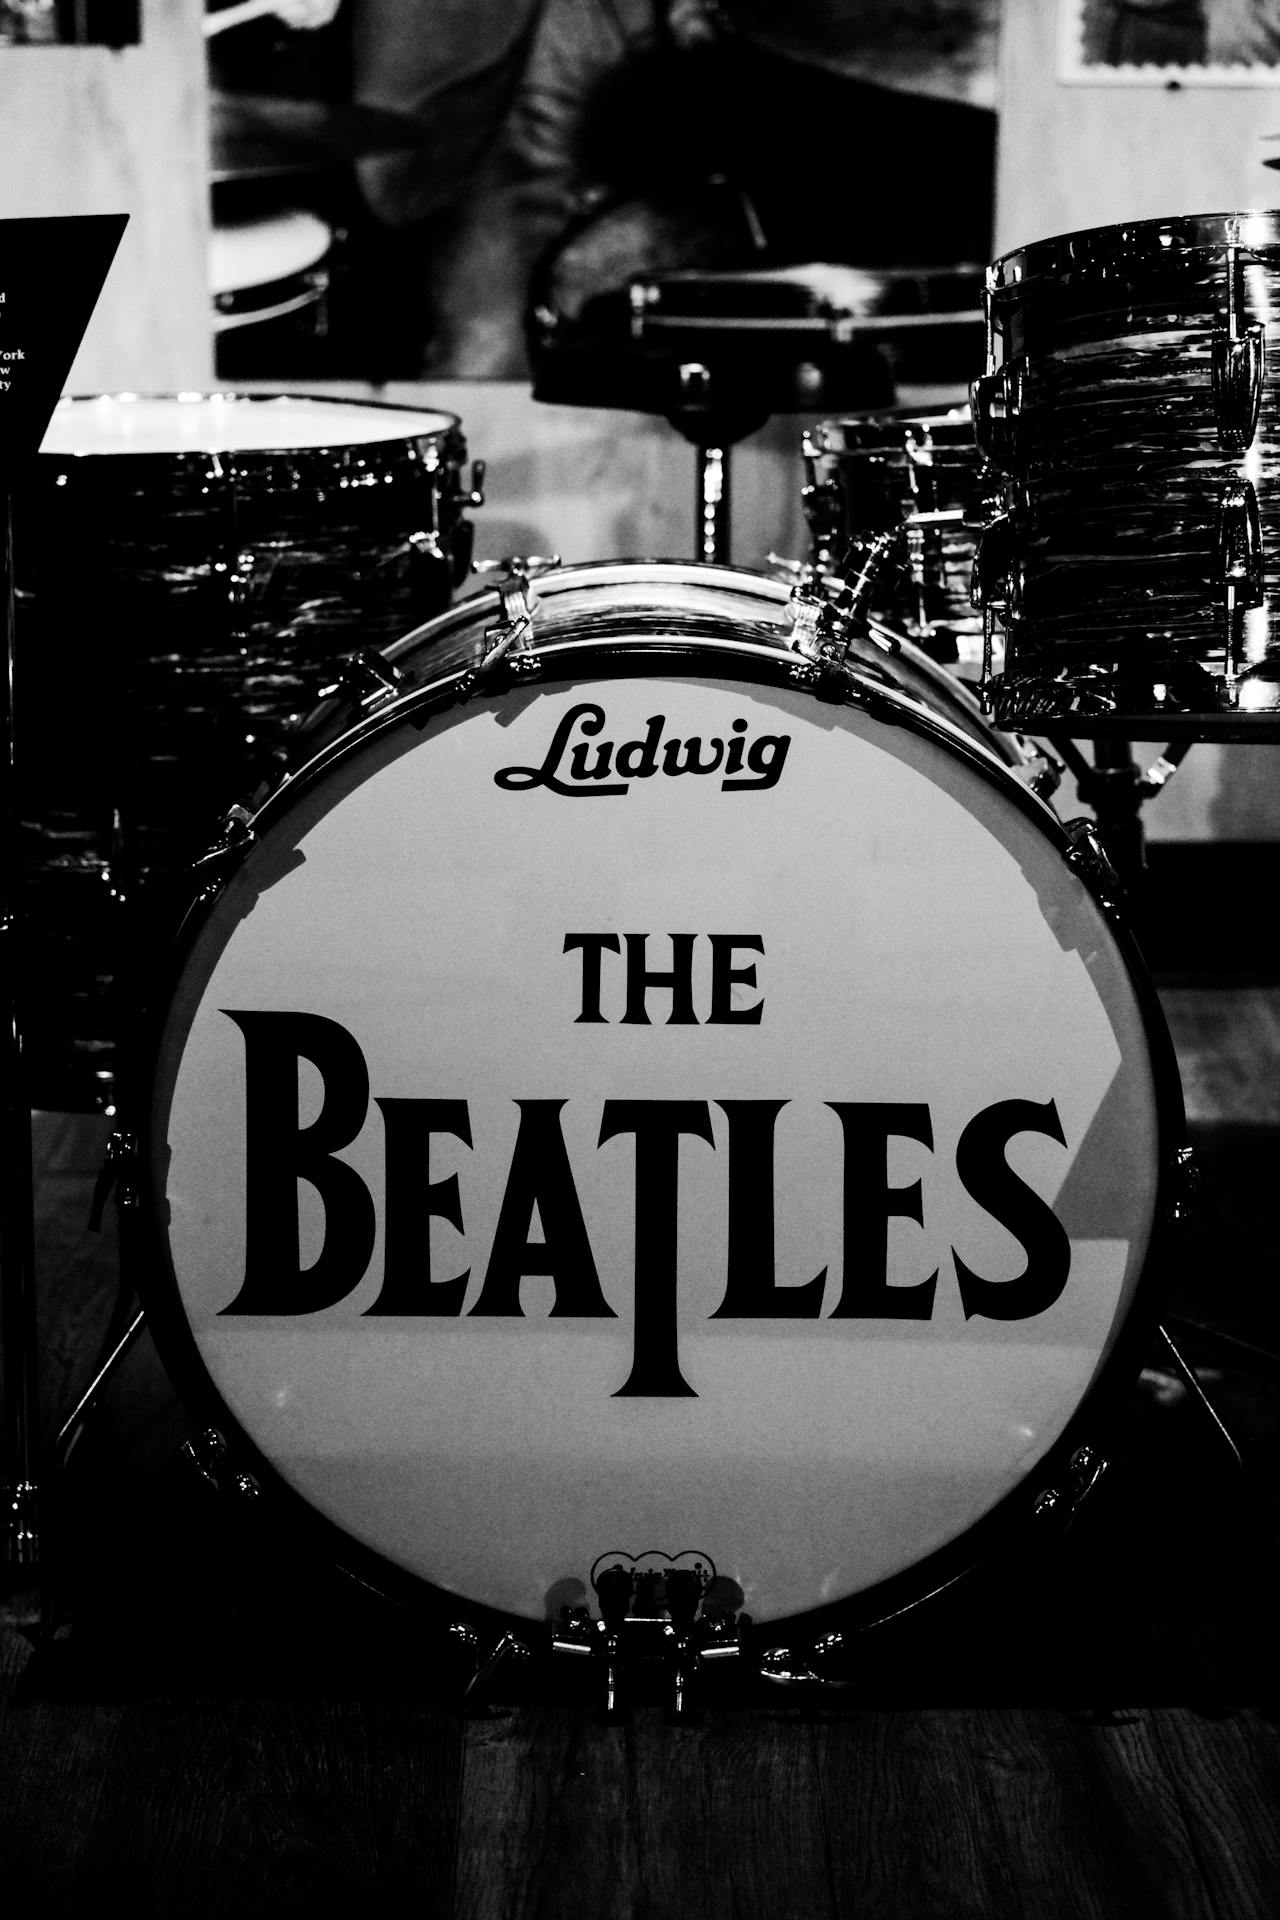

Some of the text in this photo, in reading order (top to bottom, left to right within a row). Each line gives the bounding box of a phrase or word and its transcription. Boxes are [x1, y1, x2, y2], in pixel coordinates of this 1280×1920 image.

[494, 703, 792, 798] Ludwig
[563, 933, 765, 1025] THE
[216, 1009, 1072, 1398] BEATLES
